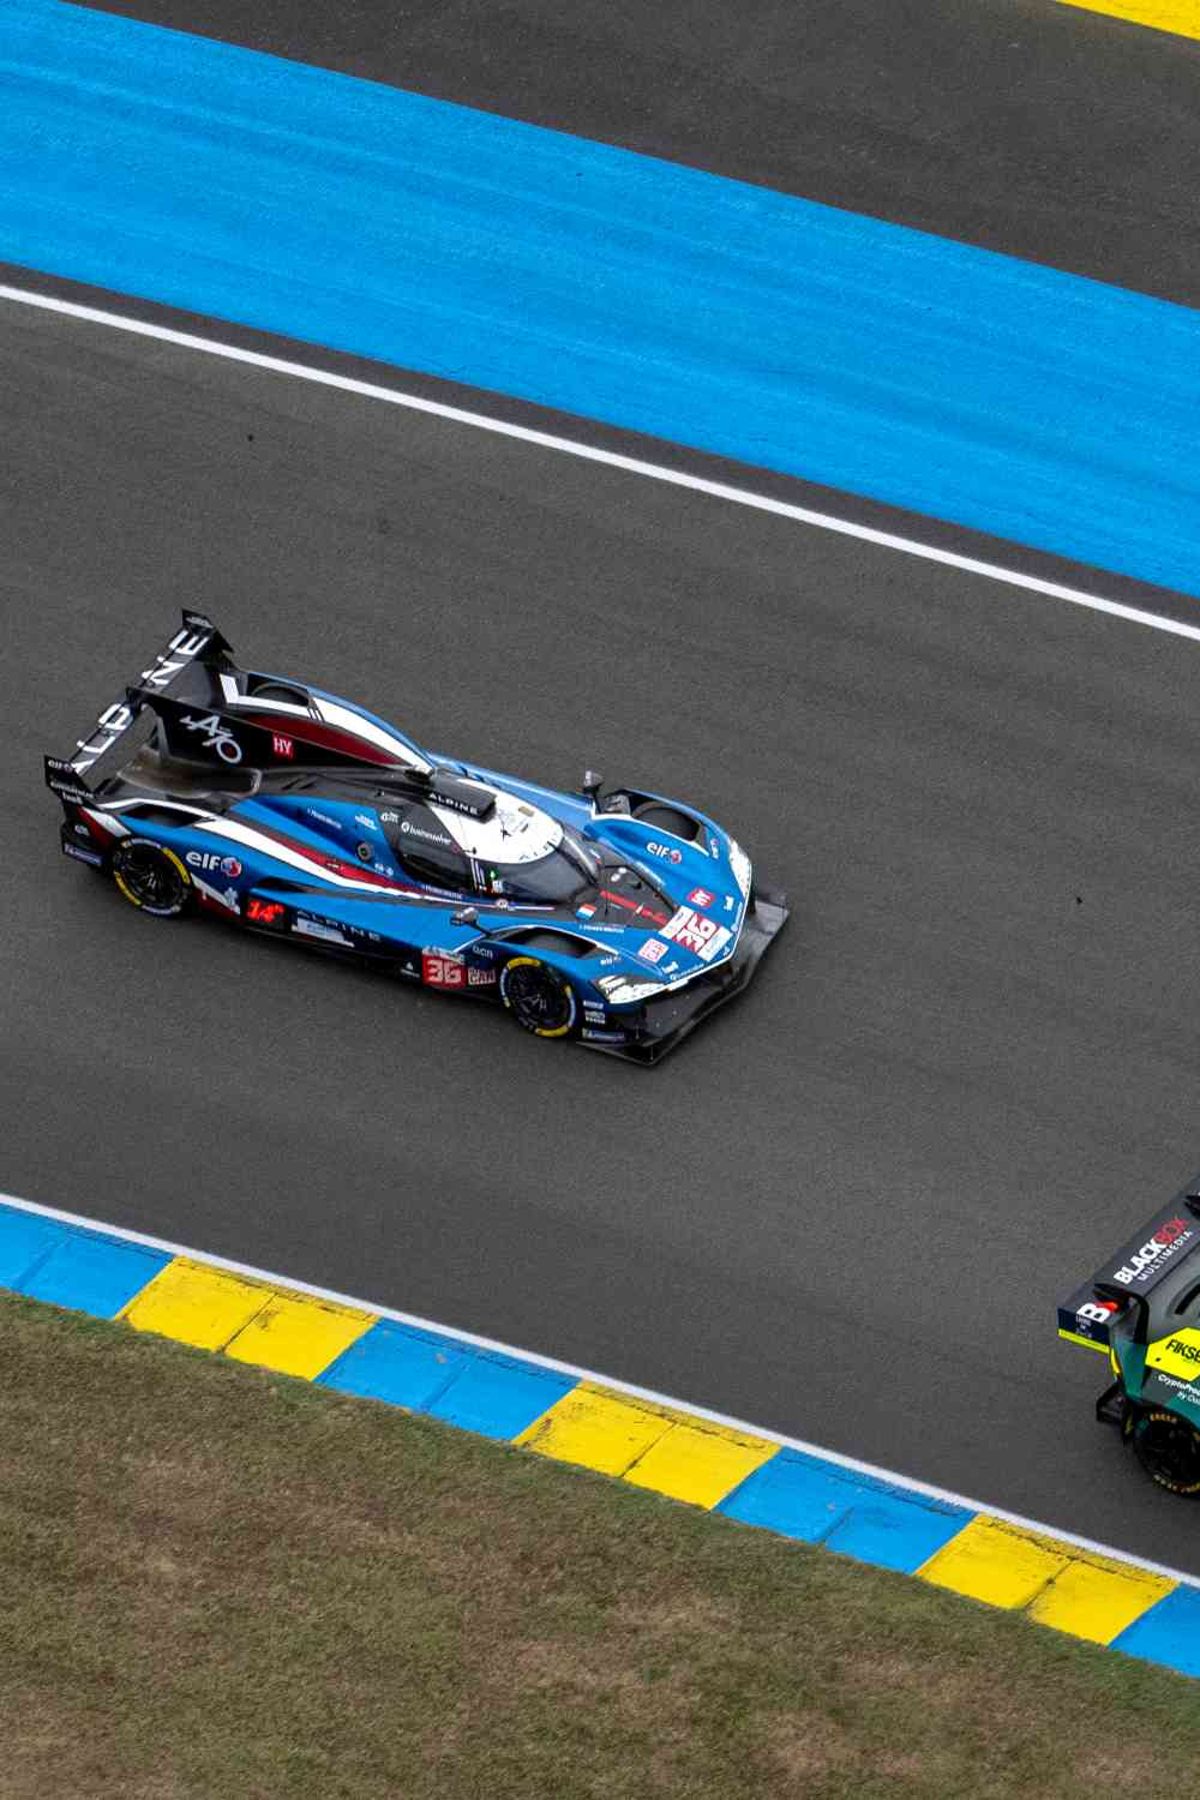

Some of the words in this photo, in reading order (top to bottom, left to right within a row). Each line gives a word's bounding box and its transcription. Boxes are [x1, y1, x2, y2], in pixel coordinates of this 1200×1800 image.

[70, 630, 209, 774] ALPNE
[429, 791, 479, 815] ALPINE
[185, 850, 220, 871] elf
[646, 842, 673, 858] elf
[426, 958, 463, 984] 36
[1113, 1217, 1190, 1285] BLACKBOX
[1137, 1231, 1194, 1282] MULTIMEDIA
